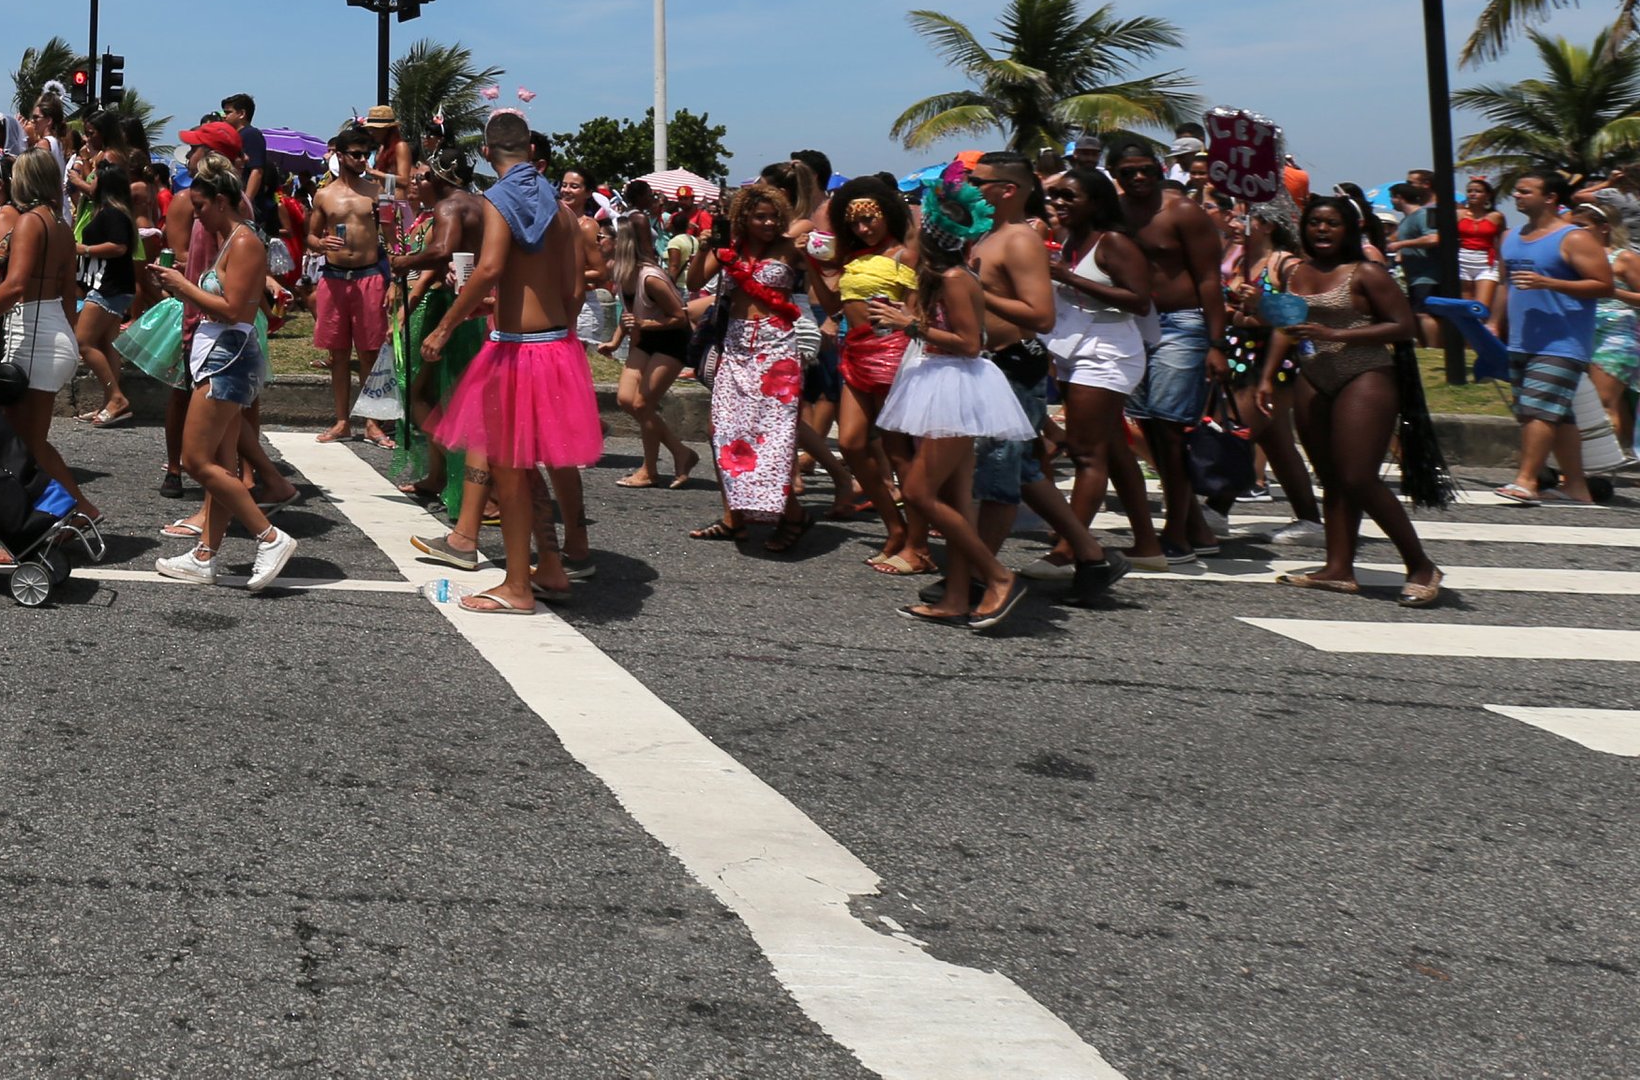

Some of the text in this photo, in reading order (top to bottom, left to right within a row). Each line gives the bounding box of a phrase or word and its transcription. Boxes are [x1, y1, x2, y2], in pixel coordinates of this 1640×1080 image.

[1209, 118, 1272, 146] LET
[1229, 146, 1256, 169] IT
[1209, 160, 1277, 198] GLOW
